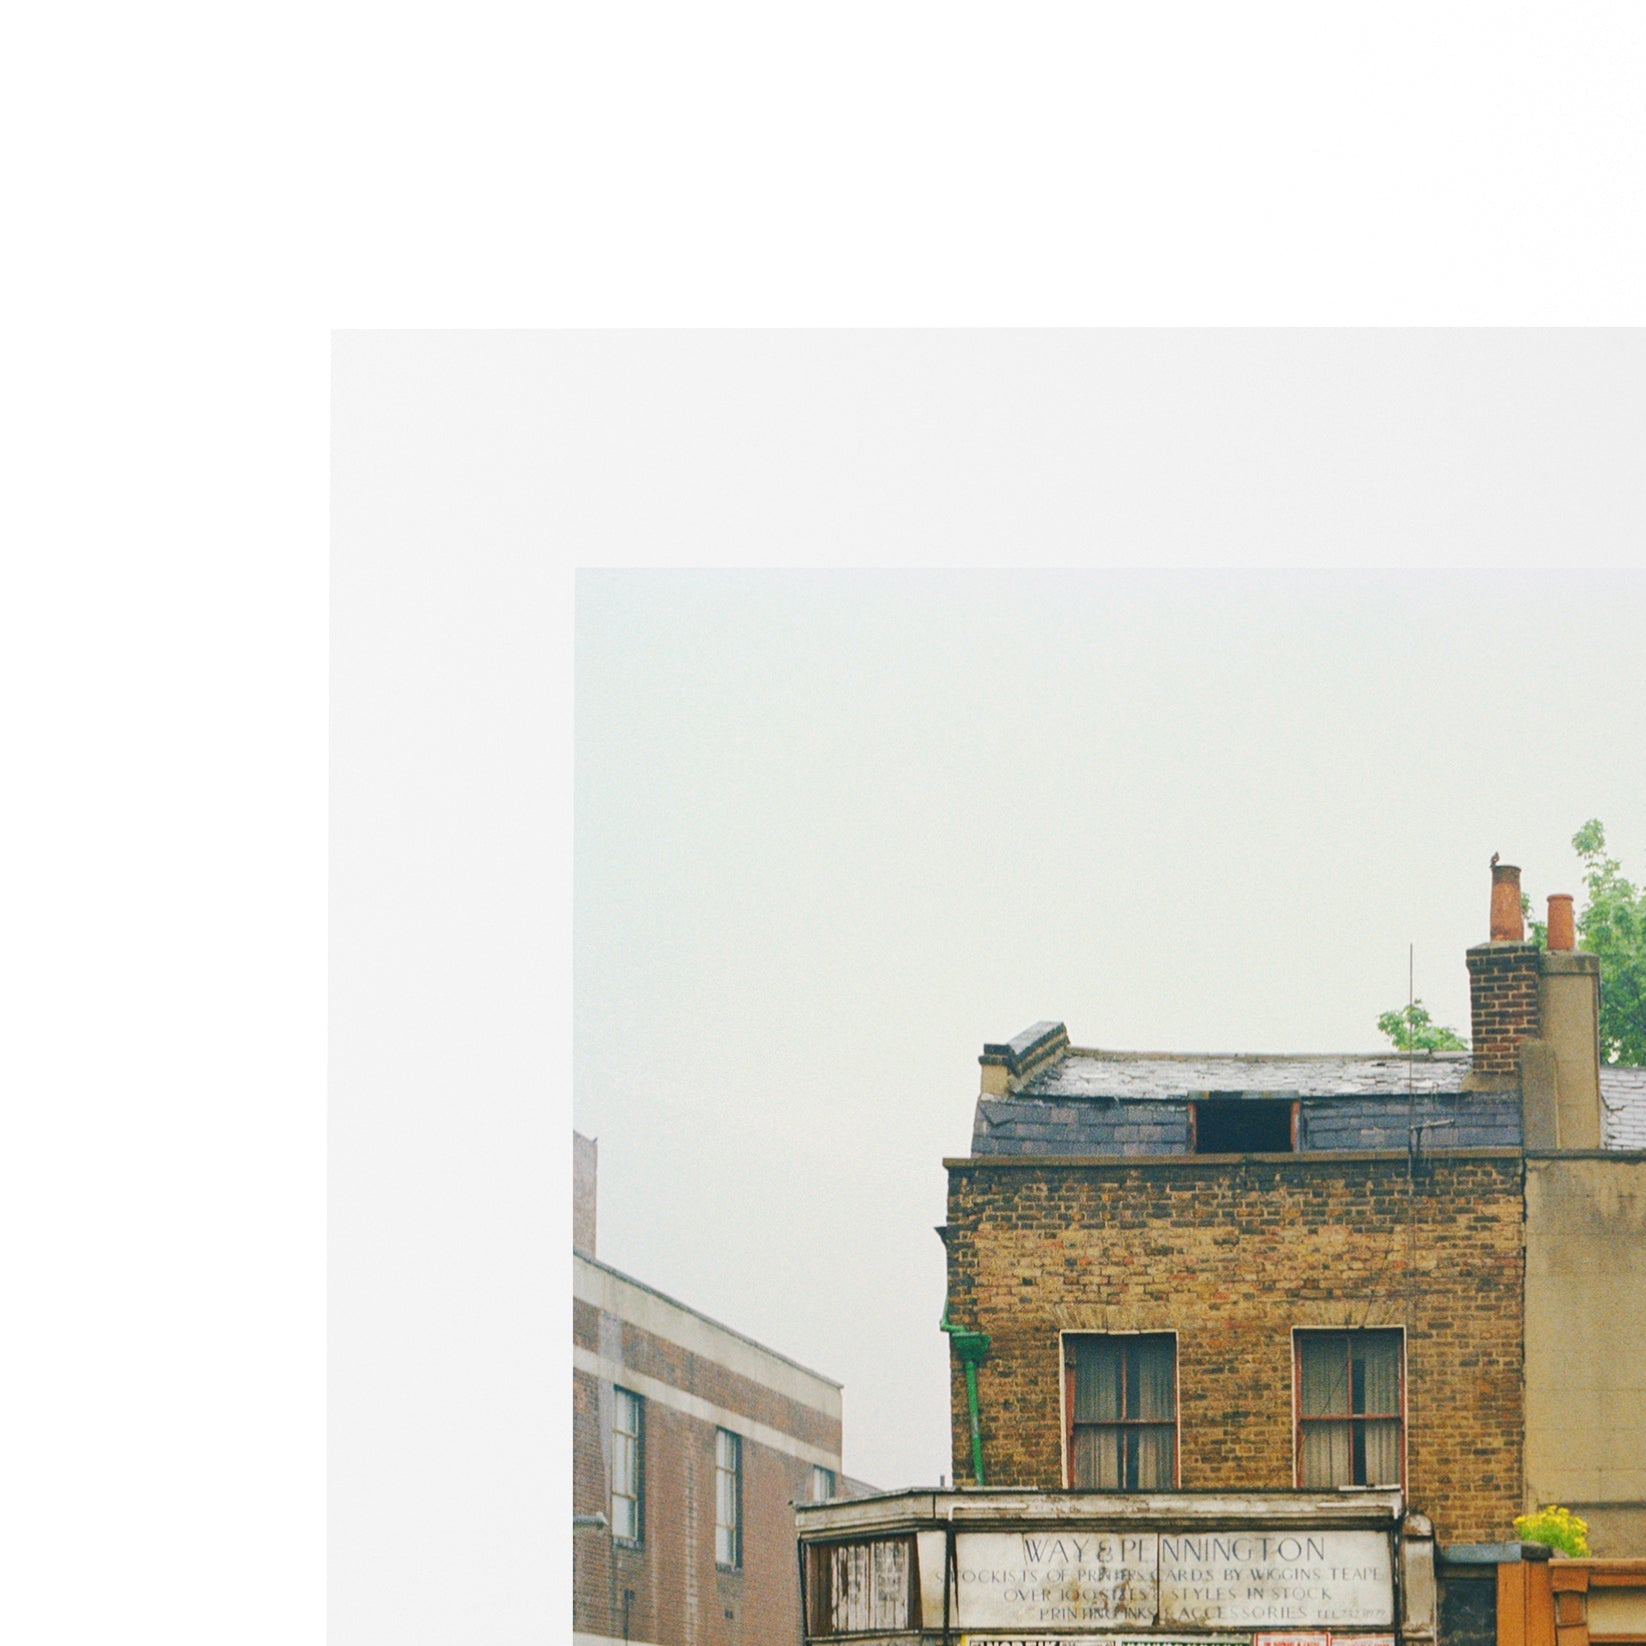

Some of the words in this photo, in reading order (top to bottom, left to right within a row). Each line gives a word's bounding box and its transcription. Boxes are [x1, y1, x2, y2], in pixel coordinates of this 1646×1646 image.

[1024, 1538, 1089, 1563] WAY
[1047, 1568, 1066, 1582] OF
[1224, 1568, 1242, 1580] BY
[1250, 1567, 1320, 1581] WIGGINS
[1330, 1566, 1382, 1580] TEAPE
[1004, 1589, 1051, 1601] OVER
[1171, 1587, 1236, 1600] STYLES
[1247, 1586, 1264, 1600] IN
[1272, 1586, 1332, 1600] STOCK
[1179, 1606, 1308, 1618] ACCESSORIES
